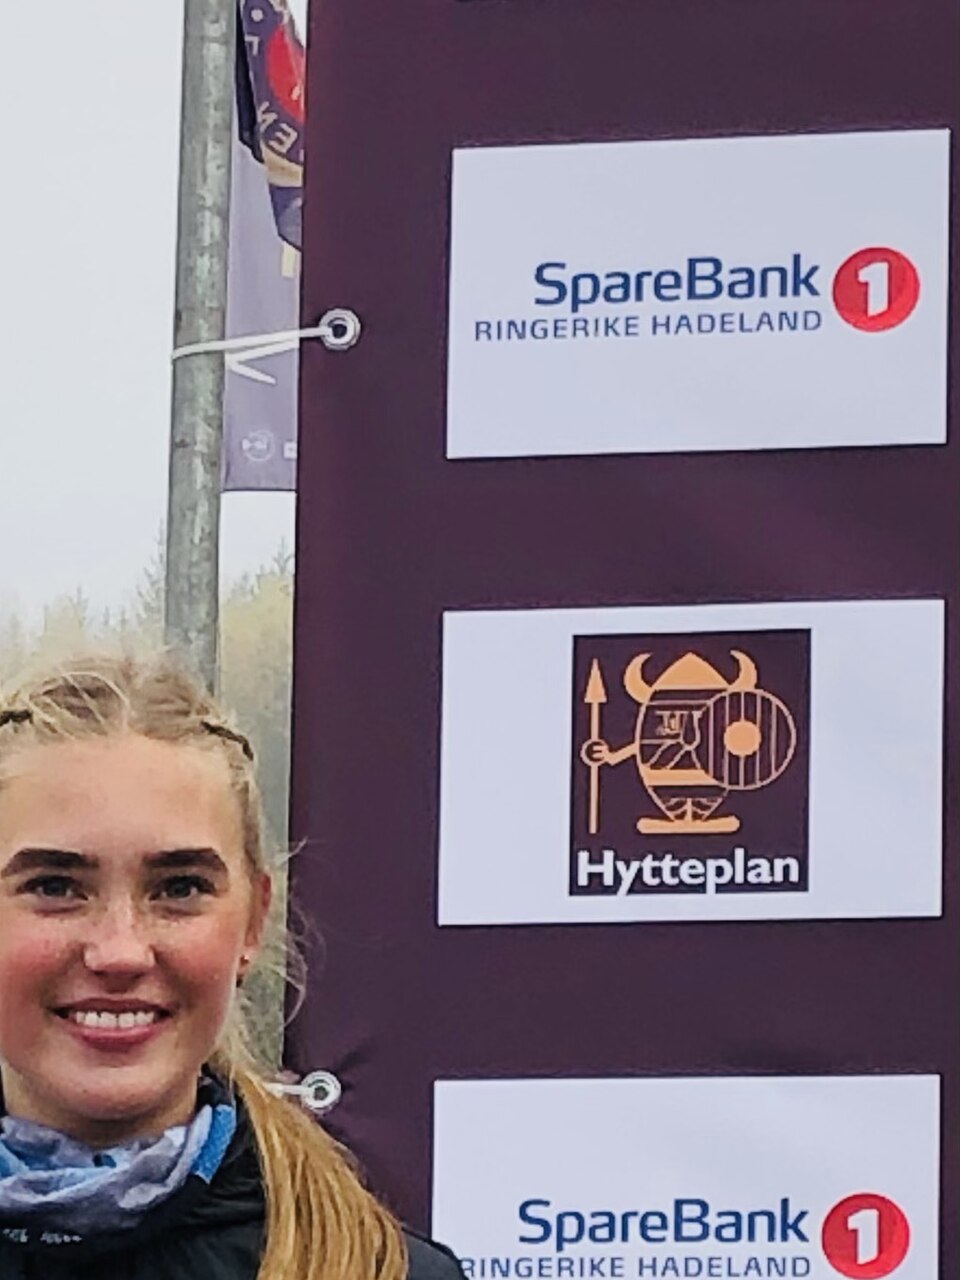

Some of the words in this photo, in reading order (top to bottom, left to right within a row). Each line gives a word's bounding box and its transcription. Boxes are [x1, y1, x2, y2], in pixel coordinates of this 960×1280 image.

[534, 253, 820, 313] SpareBank
[857, 259, 891, 320] 1
[474, 318, 639, 342] RINGERIKE
[651, 310, 823, 336] HADELAND
[577, 847, 800, 896] Hytteplan
[518, 1197, 810, 1253] SpareBank
[847, 1208, 880, 1267] 1
[460, 1256, 625, 1278] RINGERIKE
[638, 1256, 811, 1278] HADELAND
